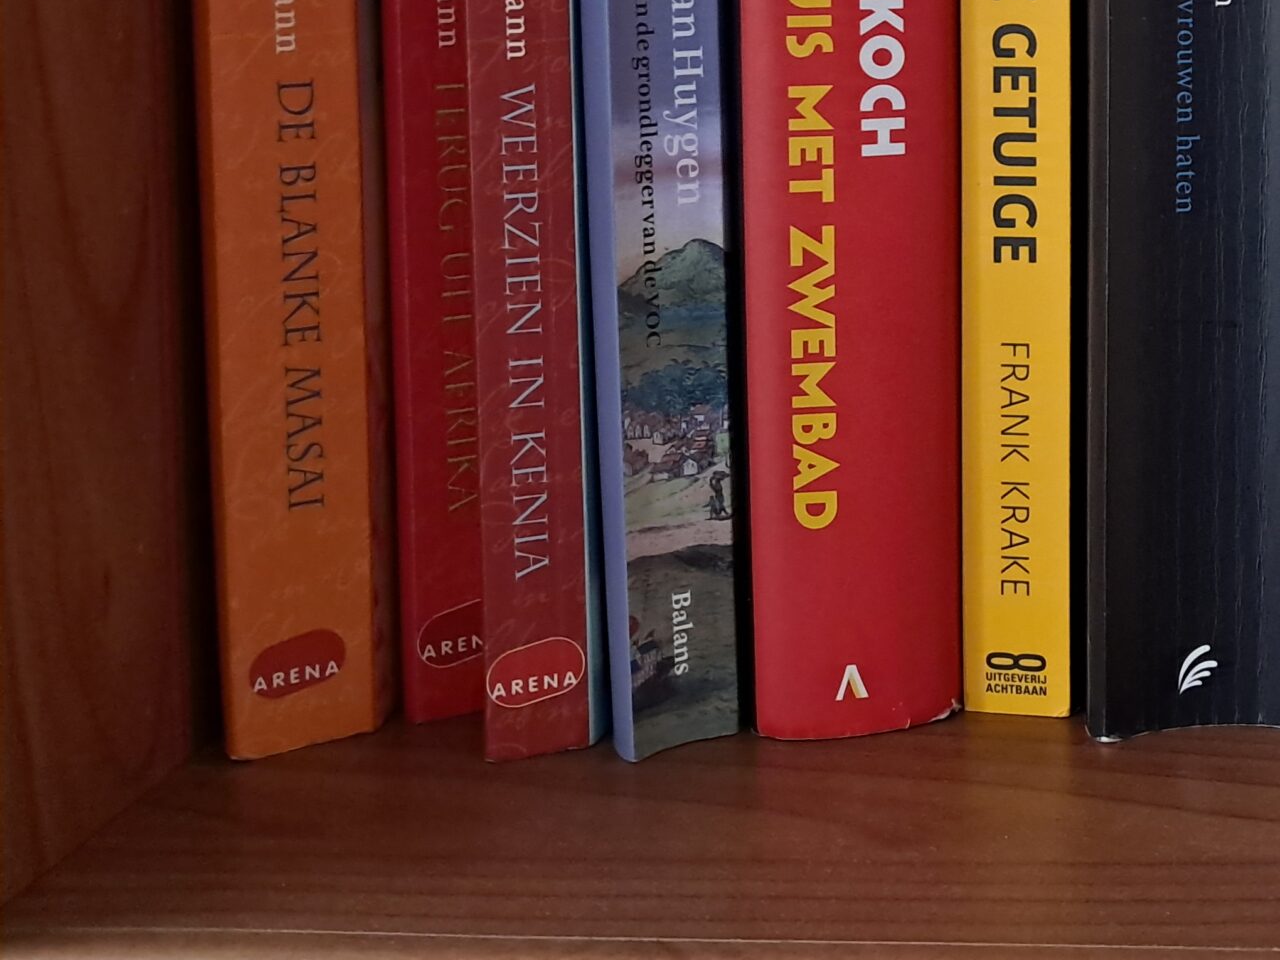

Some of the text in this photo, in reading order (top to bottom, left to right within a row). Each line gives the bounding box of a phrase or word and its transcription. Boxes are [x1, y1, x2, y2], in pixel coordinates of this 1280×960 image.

[634, 20, 656, 52] de
[276, 80, 315, 143] DE
[631, 55, 658, 211] grondlegger
[662, 46, 705, 206] Huygen
[786, 84, 835, 203] MET
[991, 23, 1038, 264] GETUIGE
[500, 82, 544, 335] WEERZIEN
[1176, 134, 1201, 215] haten
[278, 161, 322, 346] BLANKE
[641, 212, 657, 256] van
[643, 257, 662, 290] de
[508, 357, 545, 408] IN
[787, 224, 841, 530] ZWEMBAD
[1000, 341, 1031, 464] FRANK
[284, 366, 325, 511] MASAI
[442, 348, 478, 512] AFRIKA
[510, 431, 550, 581] KENIA
[1000, 480, 1031, 597] KRAKE
[252, 657, 340, 693] ARENA
[422, 633, 484, 660] AREN
[671, 589, 694, 676] Balans
[985, 672, 1048, 685] UITGEVERIJ
[491, 670, 578, 699] ARENA
[985, 683, 1048, 697] ACHTBAAN
